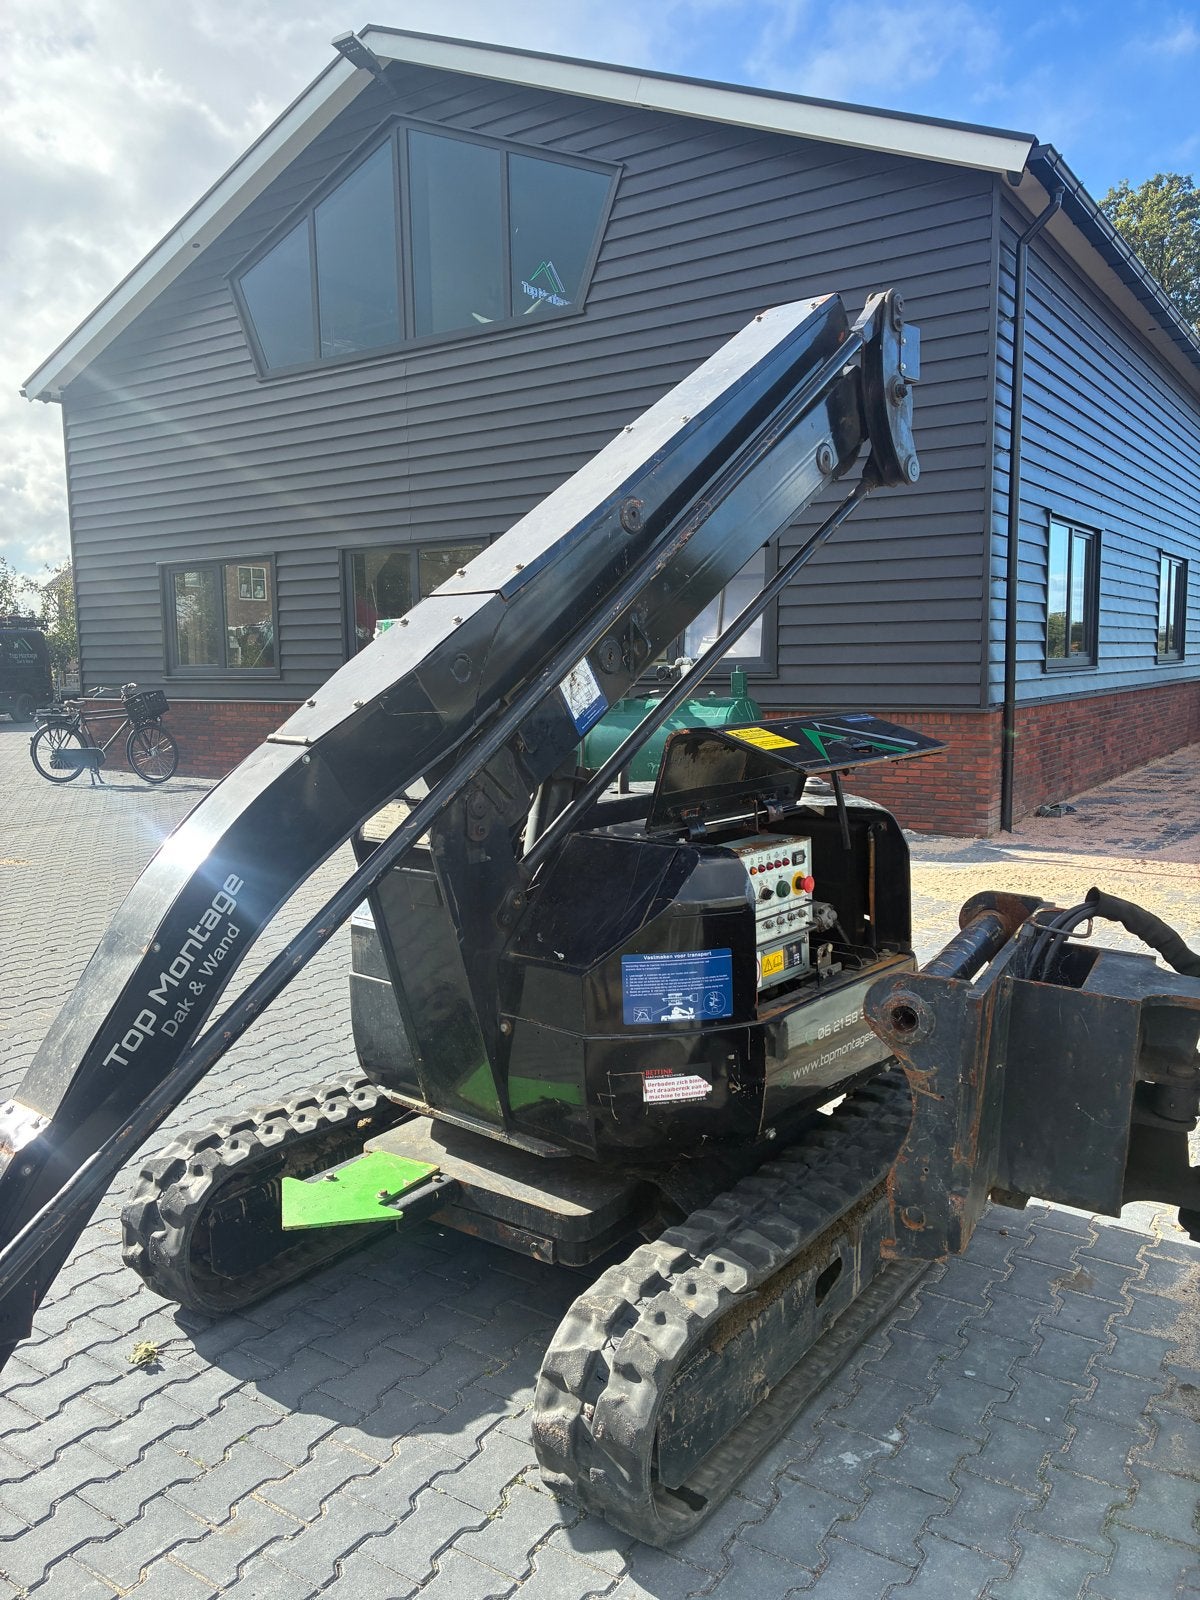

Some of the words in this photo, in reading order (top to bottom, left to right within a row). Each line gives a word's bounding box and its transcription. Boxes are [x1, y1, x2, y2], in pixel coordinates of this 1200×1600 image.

[102, 1008, 157, 1067] Top
[148, 873, 244, 1006] Montage
[161, 999, 195, 1037] Dak
[189, 980, 206, 996] &
[198, 922, 240, 977] Wand
[792, 1031, 877, 1080] www.topmontages
[817, 1024, 832, 1040] 06
